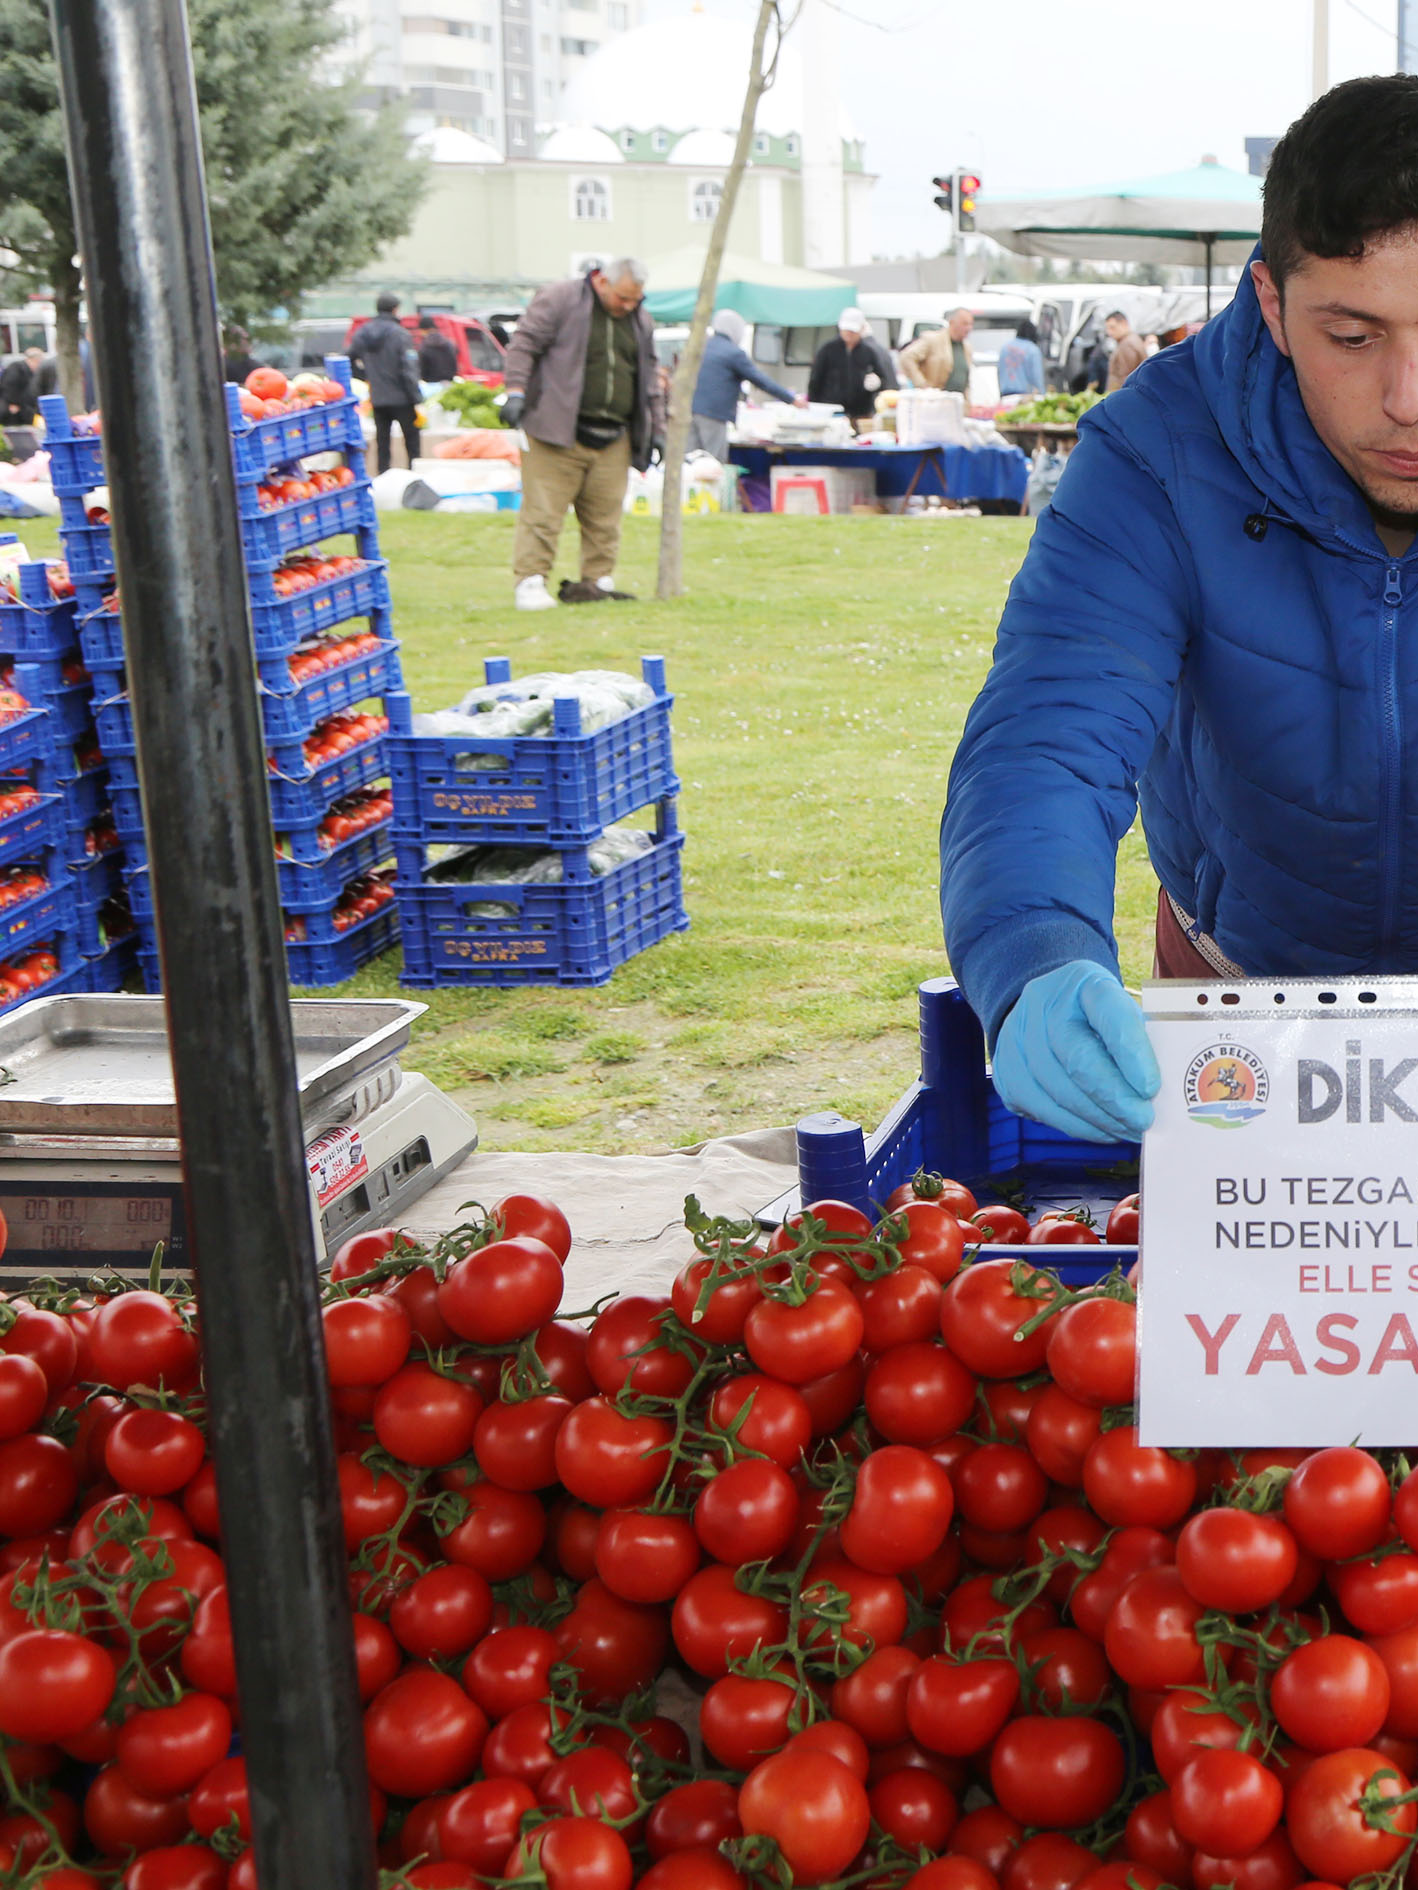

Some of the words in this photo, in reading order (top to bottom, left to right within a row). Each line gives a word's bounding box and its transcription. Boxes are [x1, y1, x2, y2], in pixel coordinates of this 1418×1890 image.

[1187, 1050, 1215, 1103] ATAKUM
[1215, 1177, 1267, 1206] BU
[1298, 1265, 1393, 1294] ELLE
